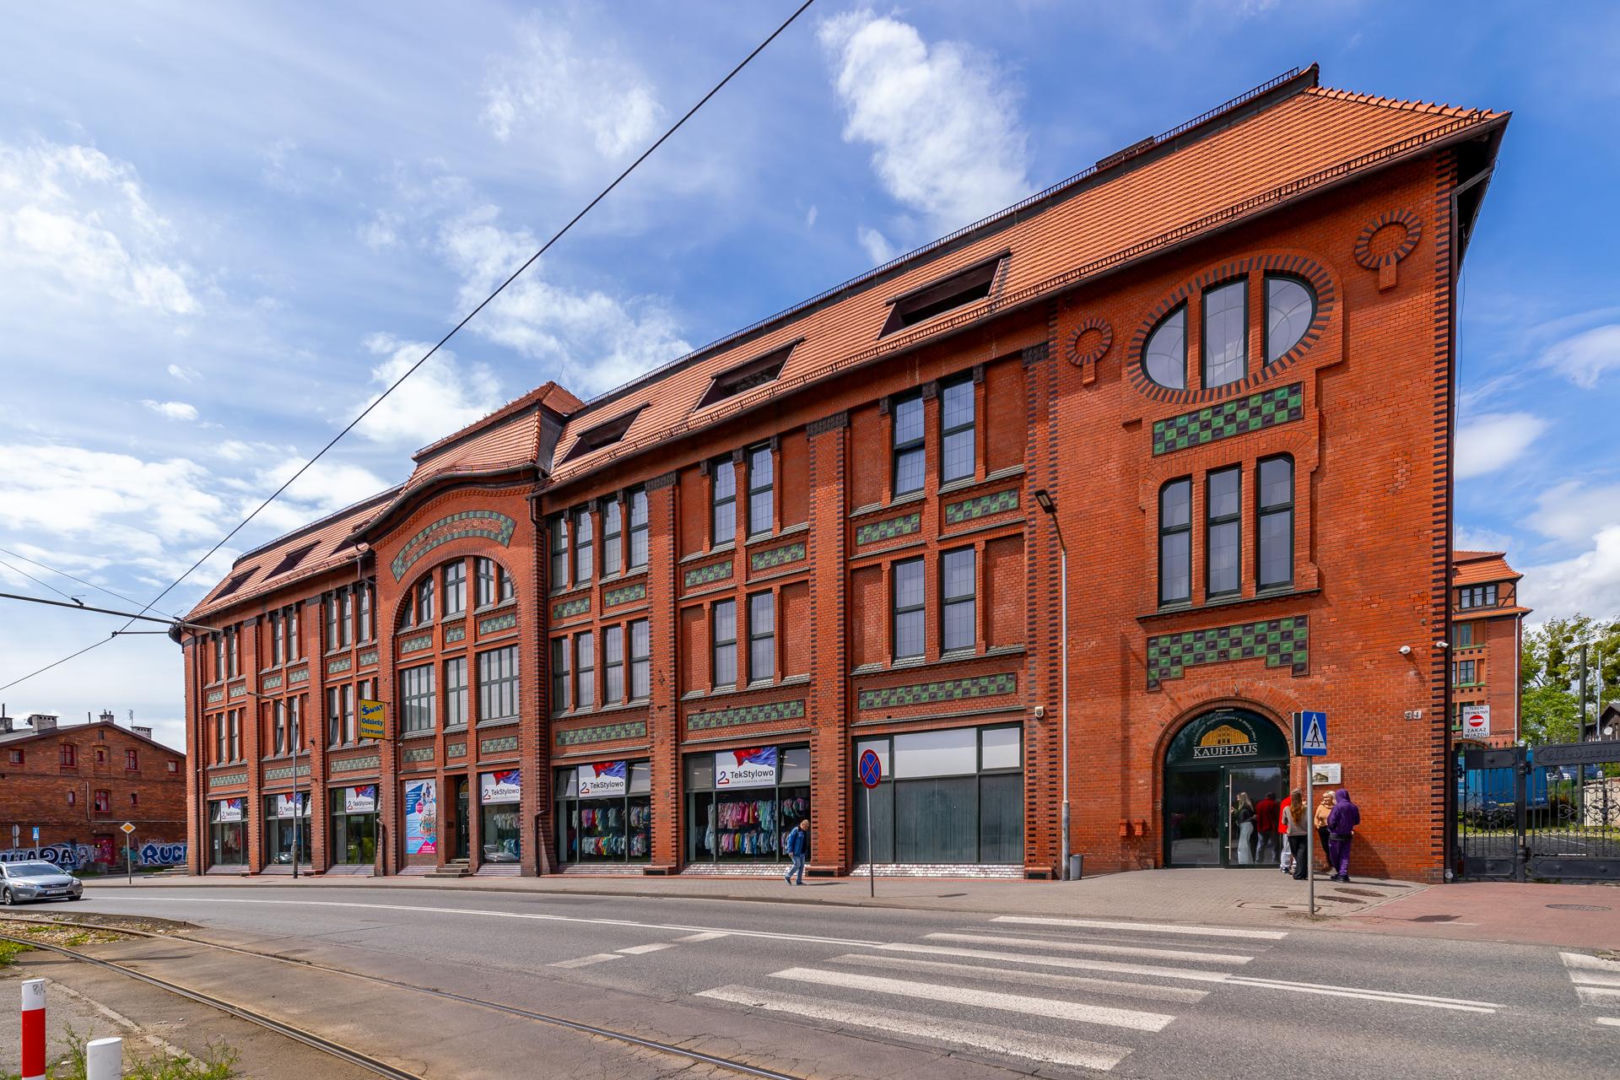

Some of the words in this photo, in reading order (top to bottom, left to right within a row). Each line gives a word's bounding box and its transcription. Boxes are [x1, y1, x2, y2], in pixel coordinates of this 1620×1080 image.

[1194, 745, 1258, 757] KAUFHAUS
[731, 769, 774, 779] TekStylowo
[590, 781, 624, 790] TekStylowo
